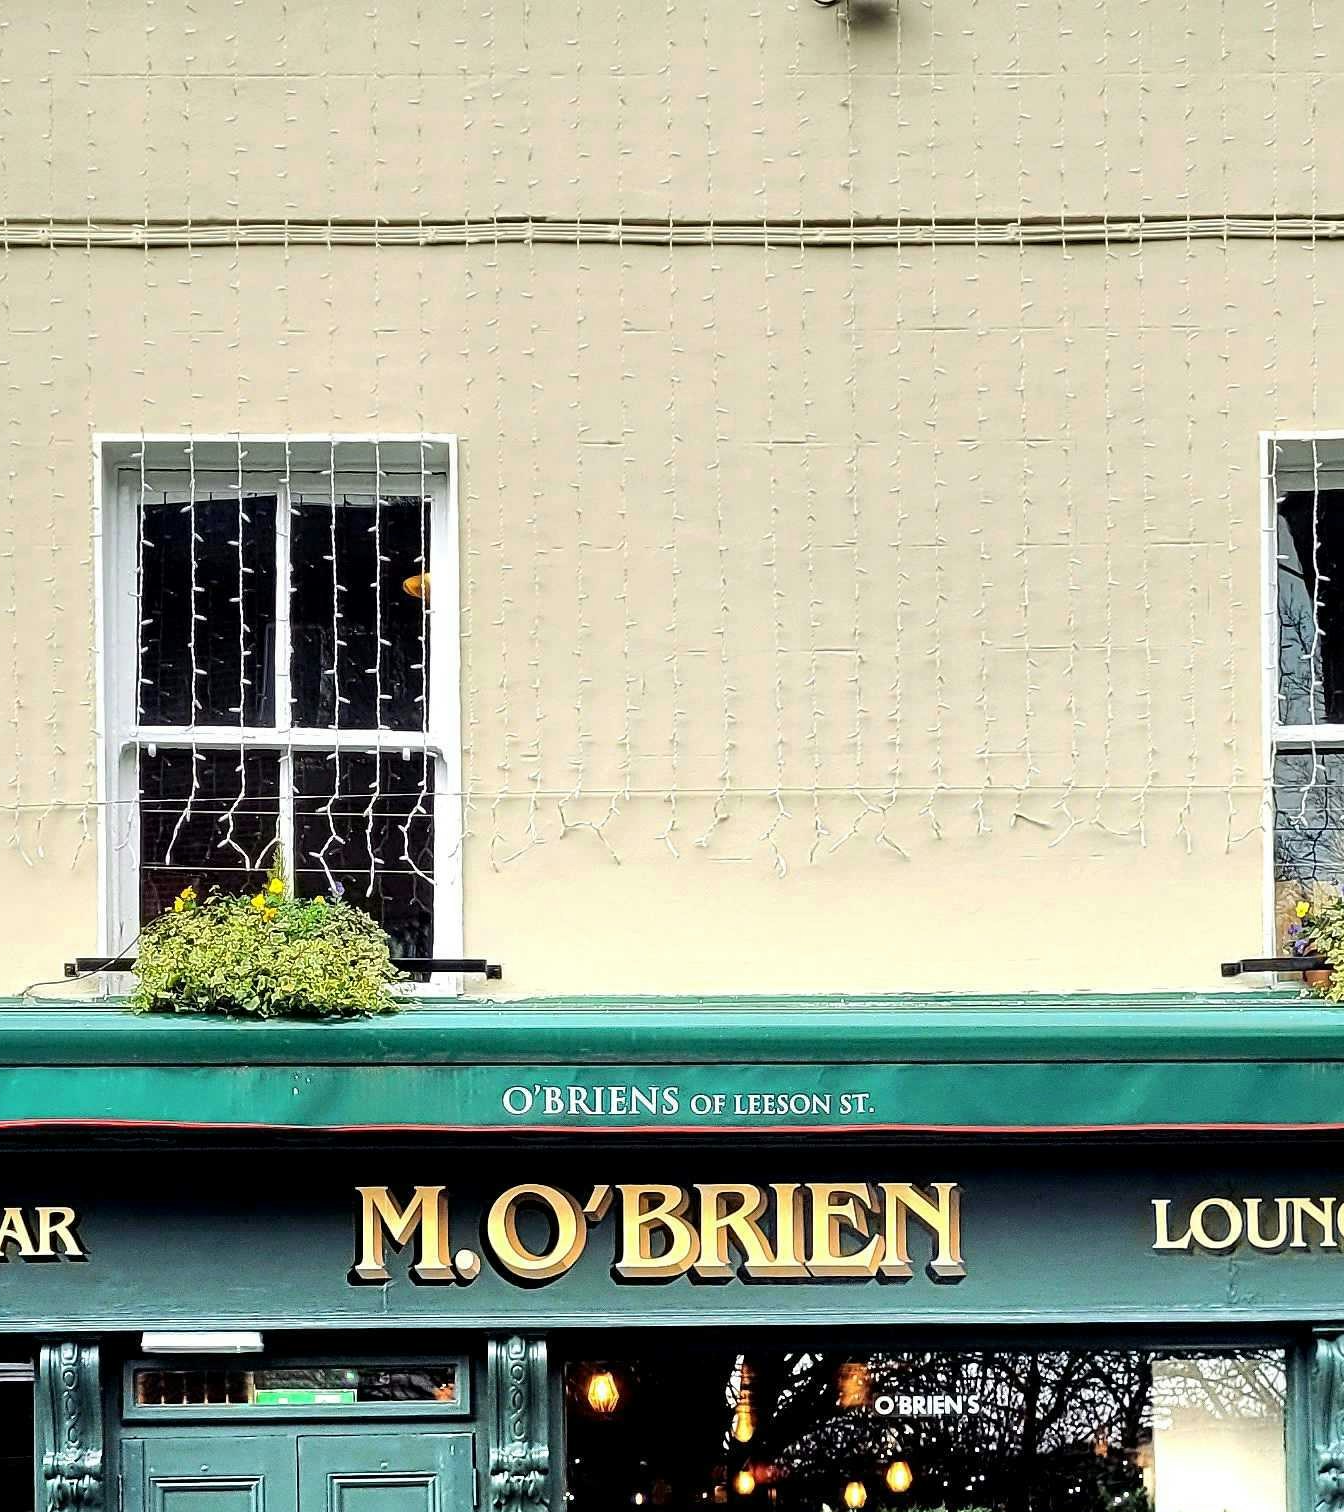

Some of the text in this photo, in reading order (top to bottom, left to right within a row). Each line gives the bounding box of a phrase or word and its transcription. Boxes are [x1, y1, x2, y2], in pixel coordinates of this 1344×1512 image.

[502, 1084, 877, 1117] O'BRIENS OF LEESON ST.
[874, 1394, 981, 1415] O'BRIEN'S
